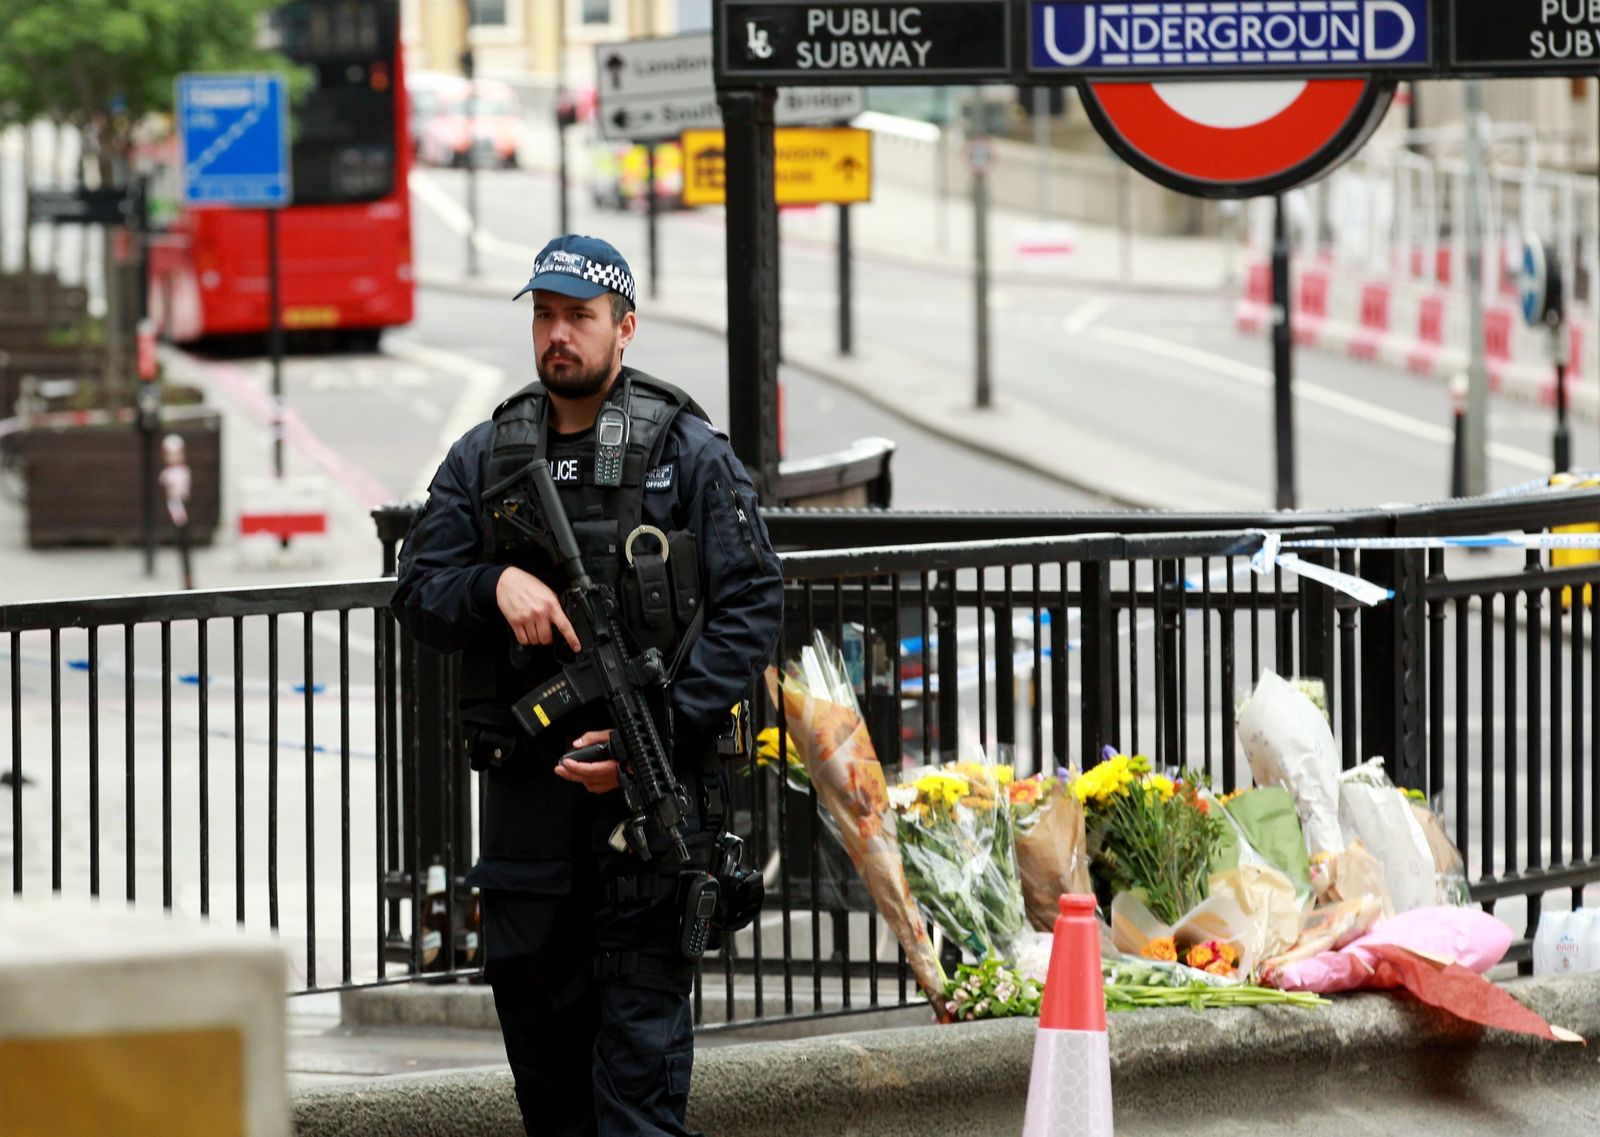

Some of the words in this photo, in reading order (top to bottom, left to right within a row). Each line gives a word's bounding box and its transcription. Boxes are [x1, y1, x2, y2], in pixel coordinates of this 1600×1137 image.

[807, 7, 922, 36] PUBLIC
[1043, 0, 1416, 66] UNDERGROUND
[796, 40, 932, 69] SUBWAY
[1530, 29, 1600, 58] SUB
[548, 459, 578, 481] LICE
[645, 479, 670, 489] OFFICER
[1540, 537, 1600, 548] POLIC
